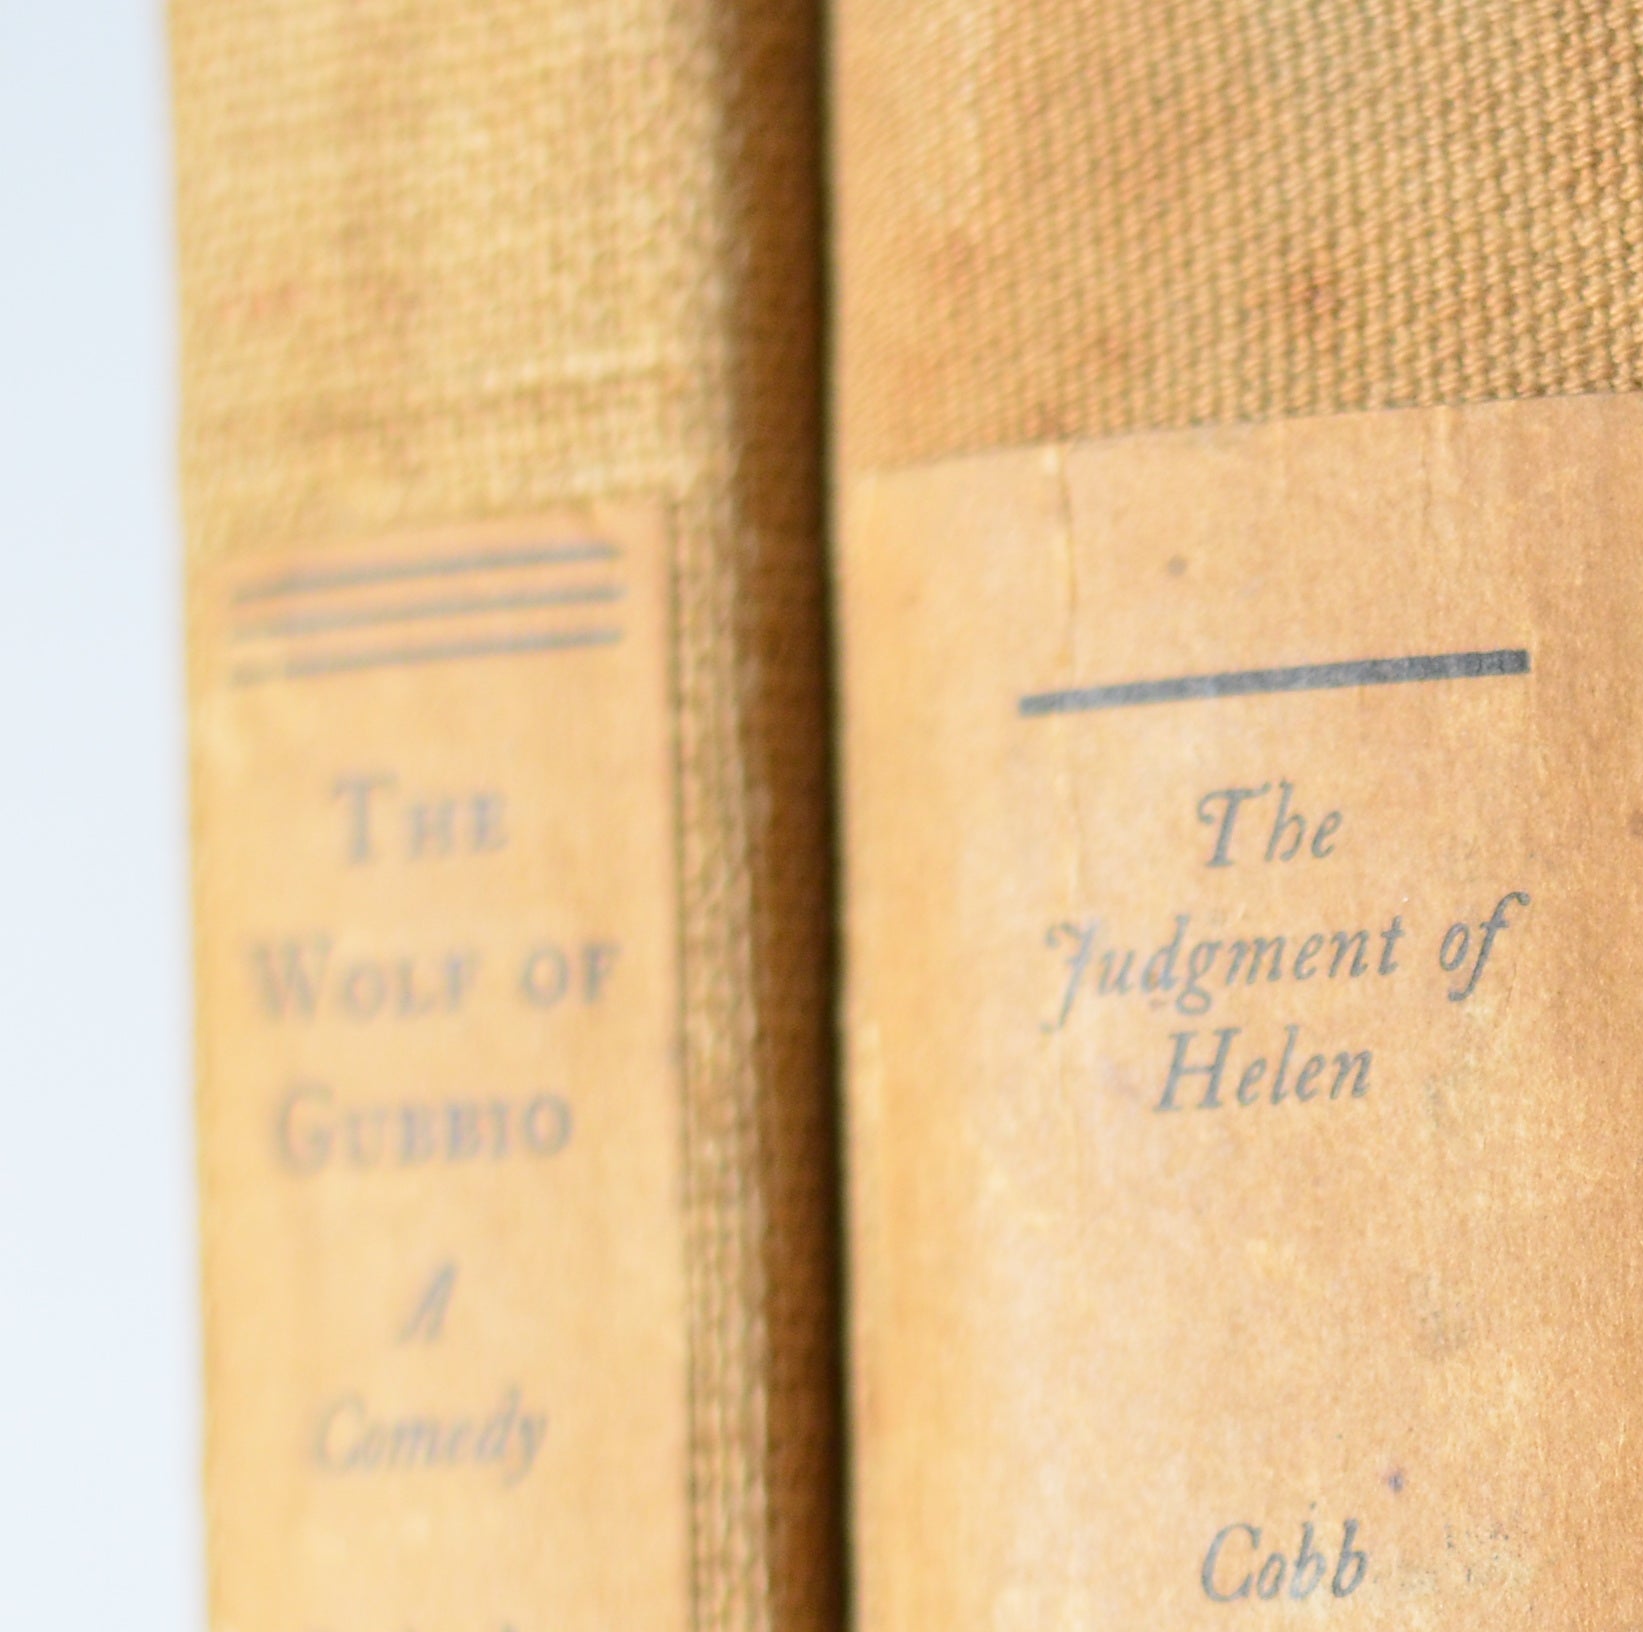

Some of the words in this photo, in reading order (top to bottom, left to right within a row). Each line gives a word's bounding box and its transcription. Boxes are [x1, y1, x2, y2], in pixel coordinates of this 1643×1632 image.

[1196, 780, 1344, 868] The
[520, 938, 620, 1008] OF
[1038, 912, 1405, 1034] Judgment
[1438, 890, 1531, 1002] of
[1152, 1025, 1374, 1114] Helen
[398, 1258, 458, 1344] A
[315, 1386, 549, 1490] Comedy
[1199, 1516, 1370, 1603] Cobb
